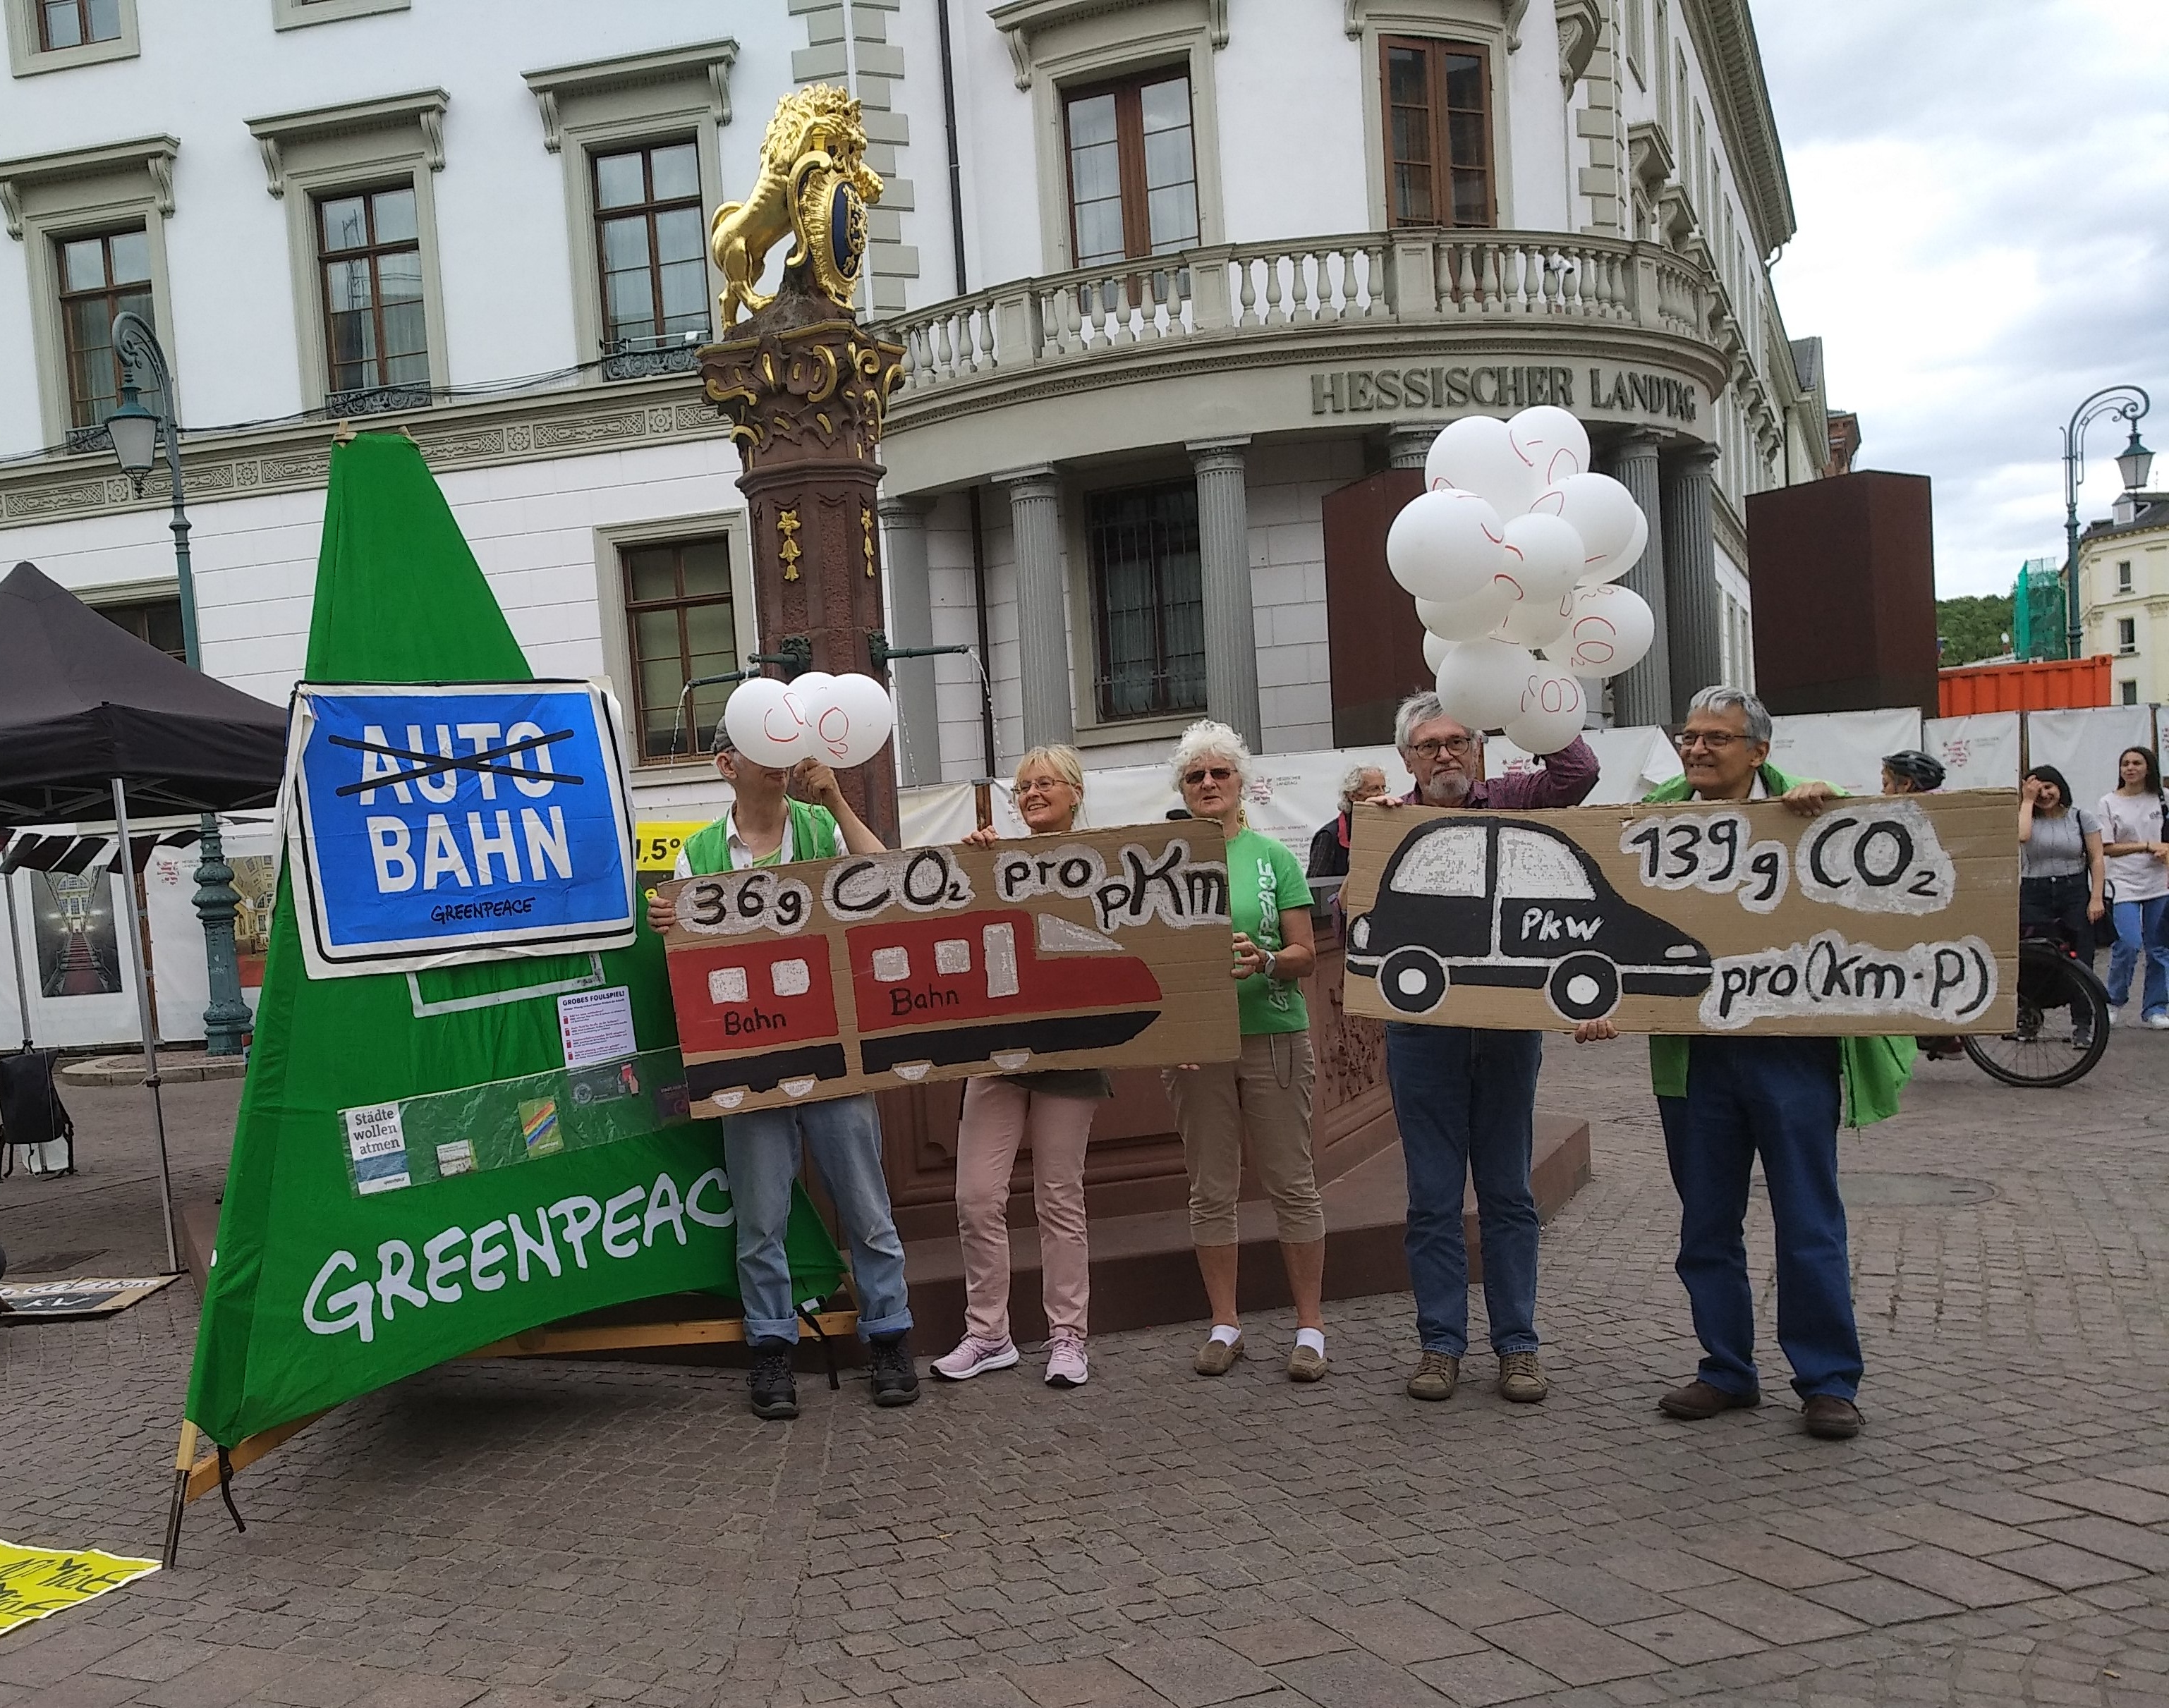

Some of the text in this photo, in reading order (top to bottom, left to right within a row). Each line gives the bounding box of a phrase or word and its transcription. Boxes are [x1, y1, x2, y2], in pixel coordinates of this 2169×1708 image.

[1311, 365, 1697, 422] HESSISCHER LANDTAG
[360, 721, 555, 805] AUTO
[366, 806, 573, 893] BAHN
[691, 874, 803, 926] 36g
[1004, 857, 1094, 898] pro
[430, 897, 536, 925] GREENPEACE
[562, 996, 589, 1006] GROBES
[590, 990, 625, 1002] FOULSPIEL!
[891, 987, 960, 1017] Bahn
[724, 1008, 787, 1037] Bahn
[355, 1109, 394, 1126] Städte
[353, 1125, 398, 1141] wollen
[359, 1138, 401, 1155] atmen
[303, 1168, 738, 1343] GREENPEAC
